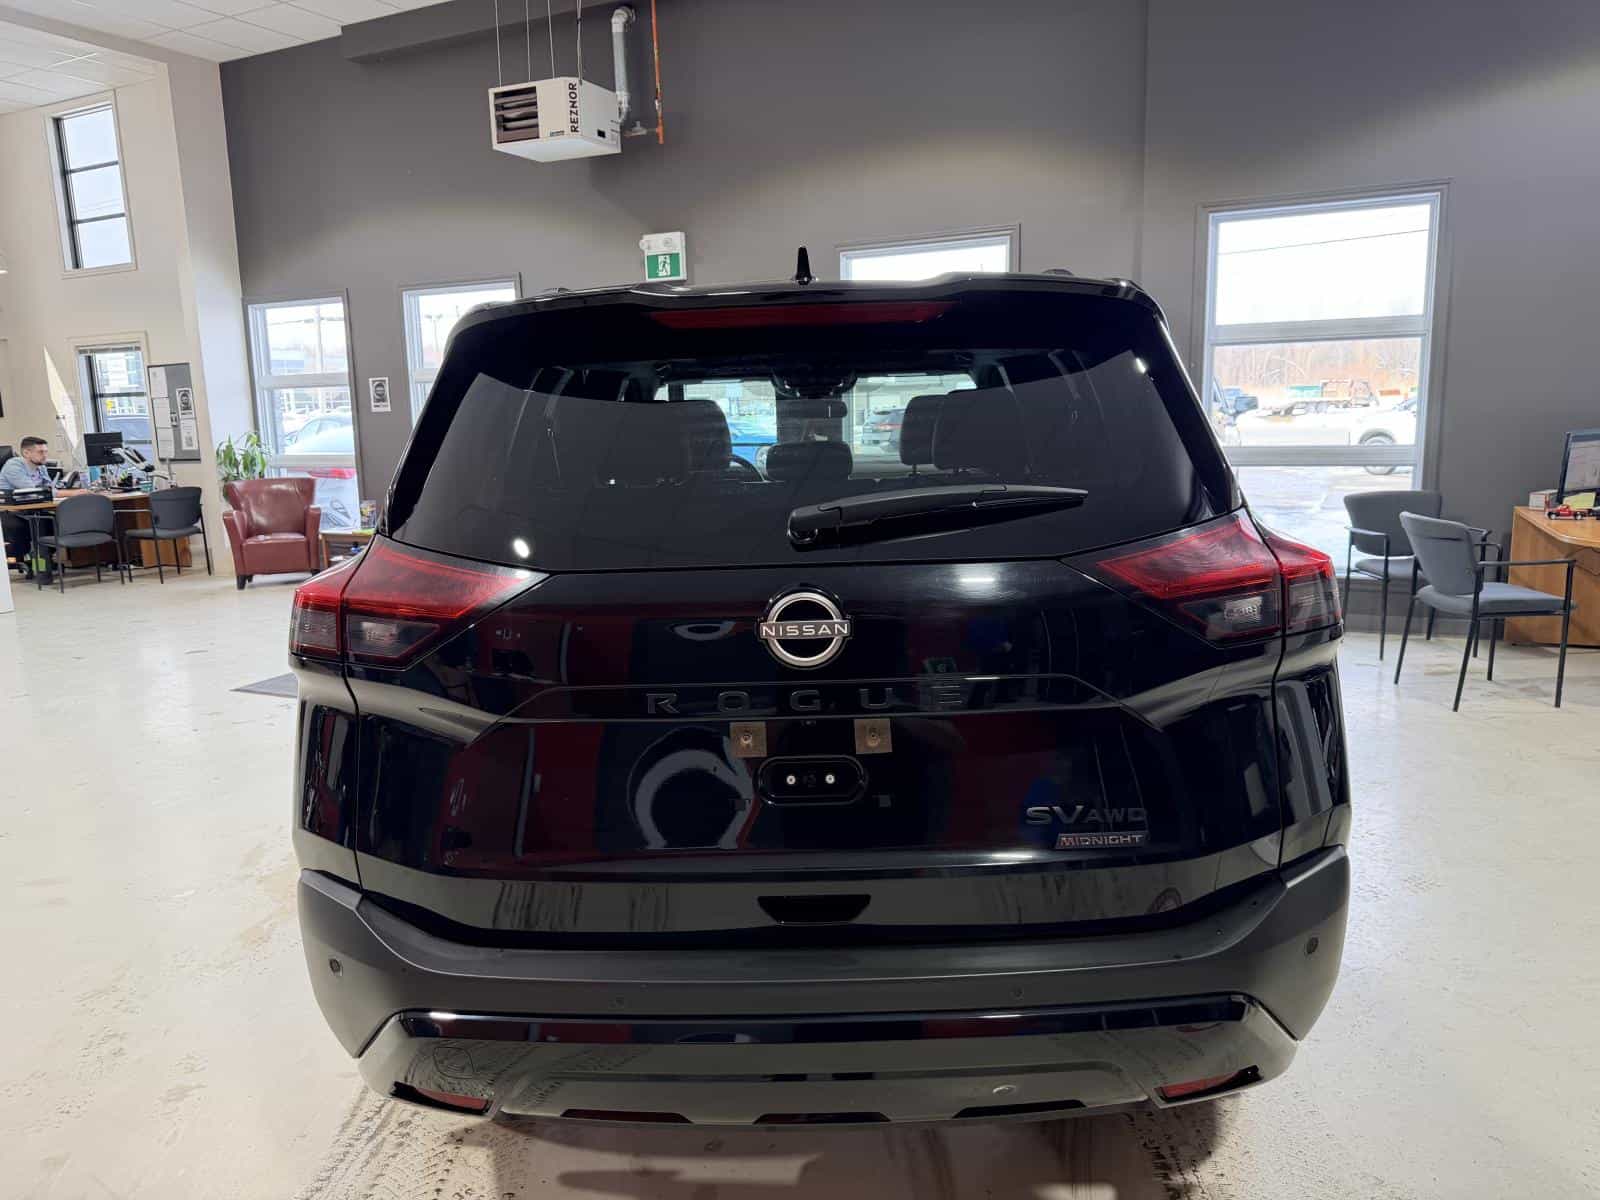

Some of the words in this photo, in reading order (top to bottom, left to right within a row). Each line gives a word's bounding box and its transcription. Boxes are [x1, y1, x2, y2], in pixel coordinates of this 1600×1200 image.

[568, 82, 579, 133] REZNOR
[762, 623, 848, 637] NISSAN
[646, 684, 962, 715] ROGUE
[1025, 805, 1085, 824] SV
[1061, 834, 1144, 848] MIDNIGHT
